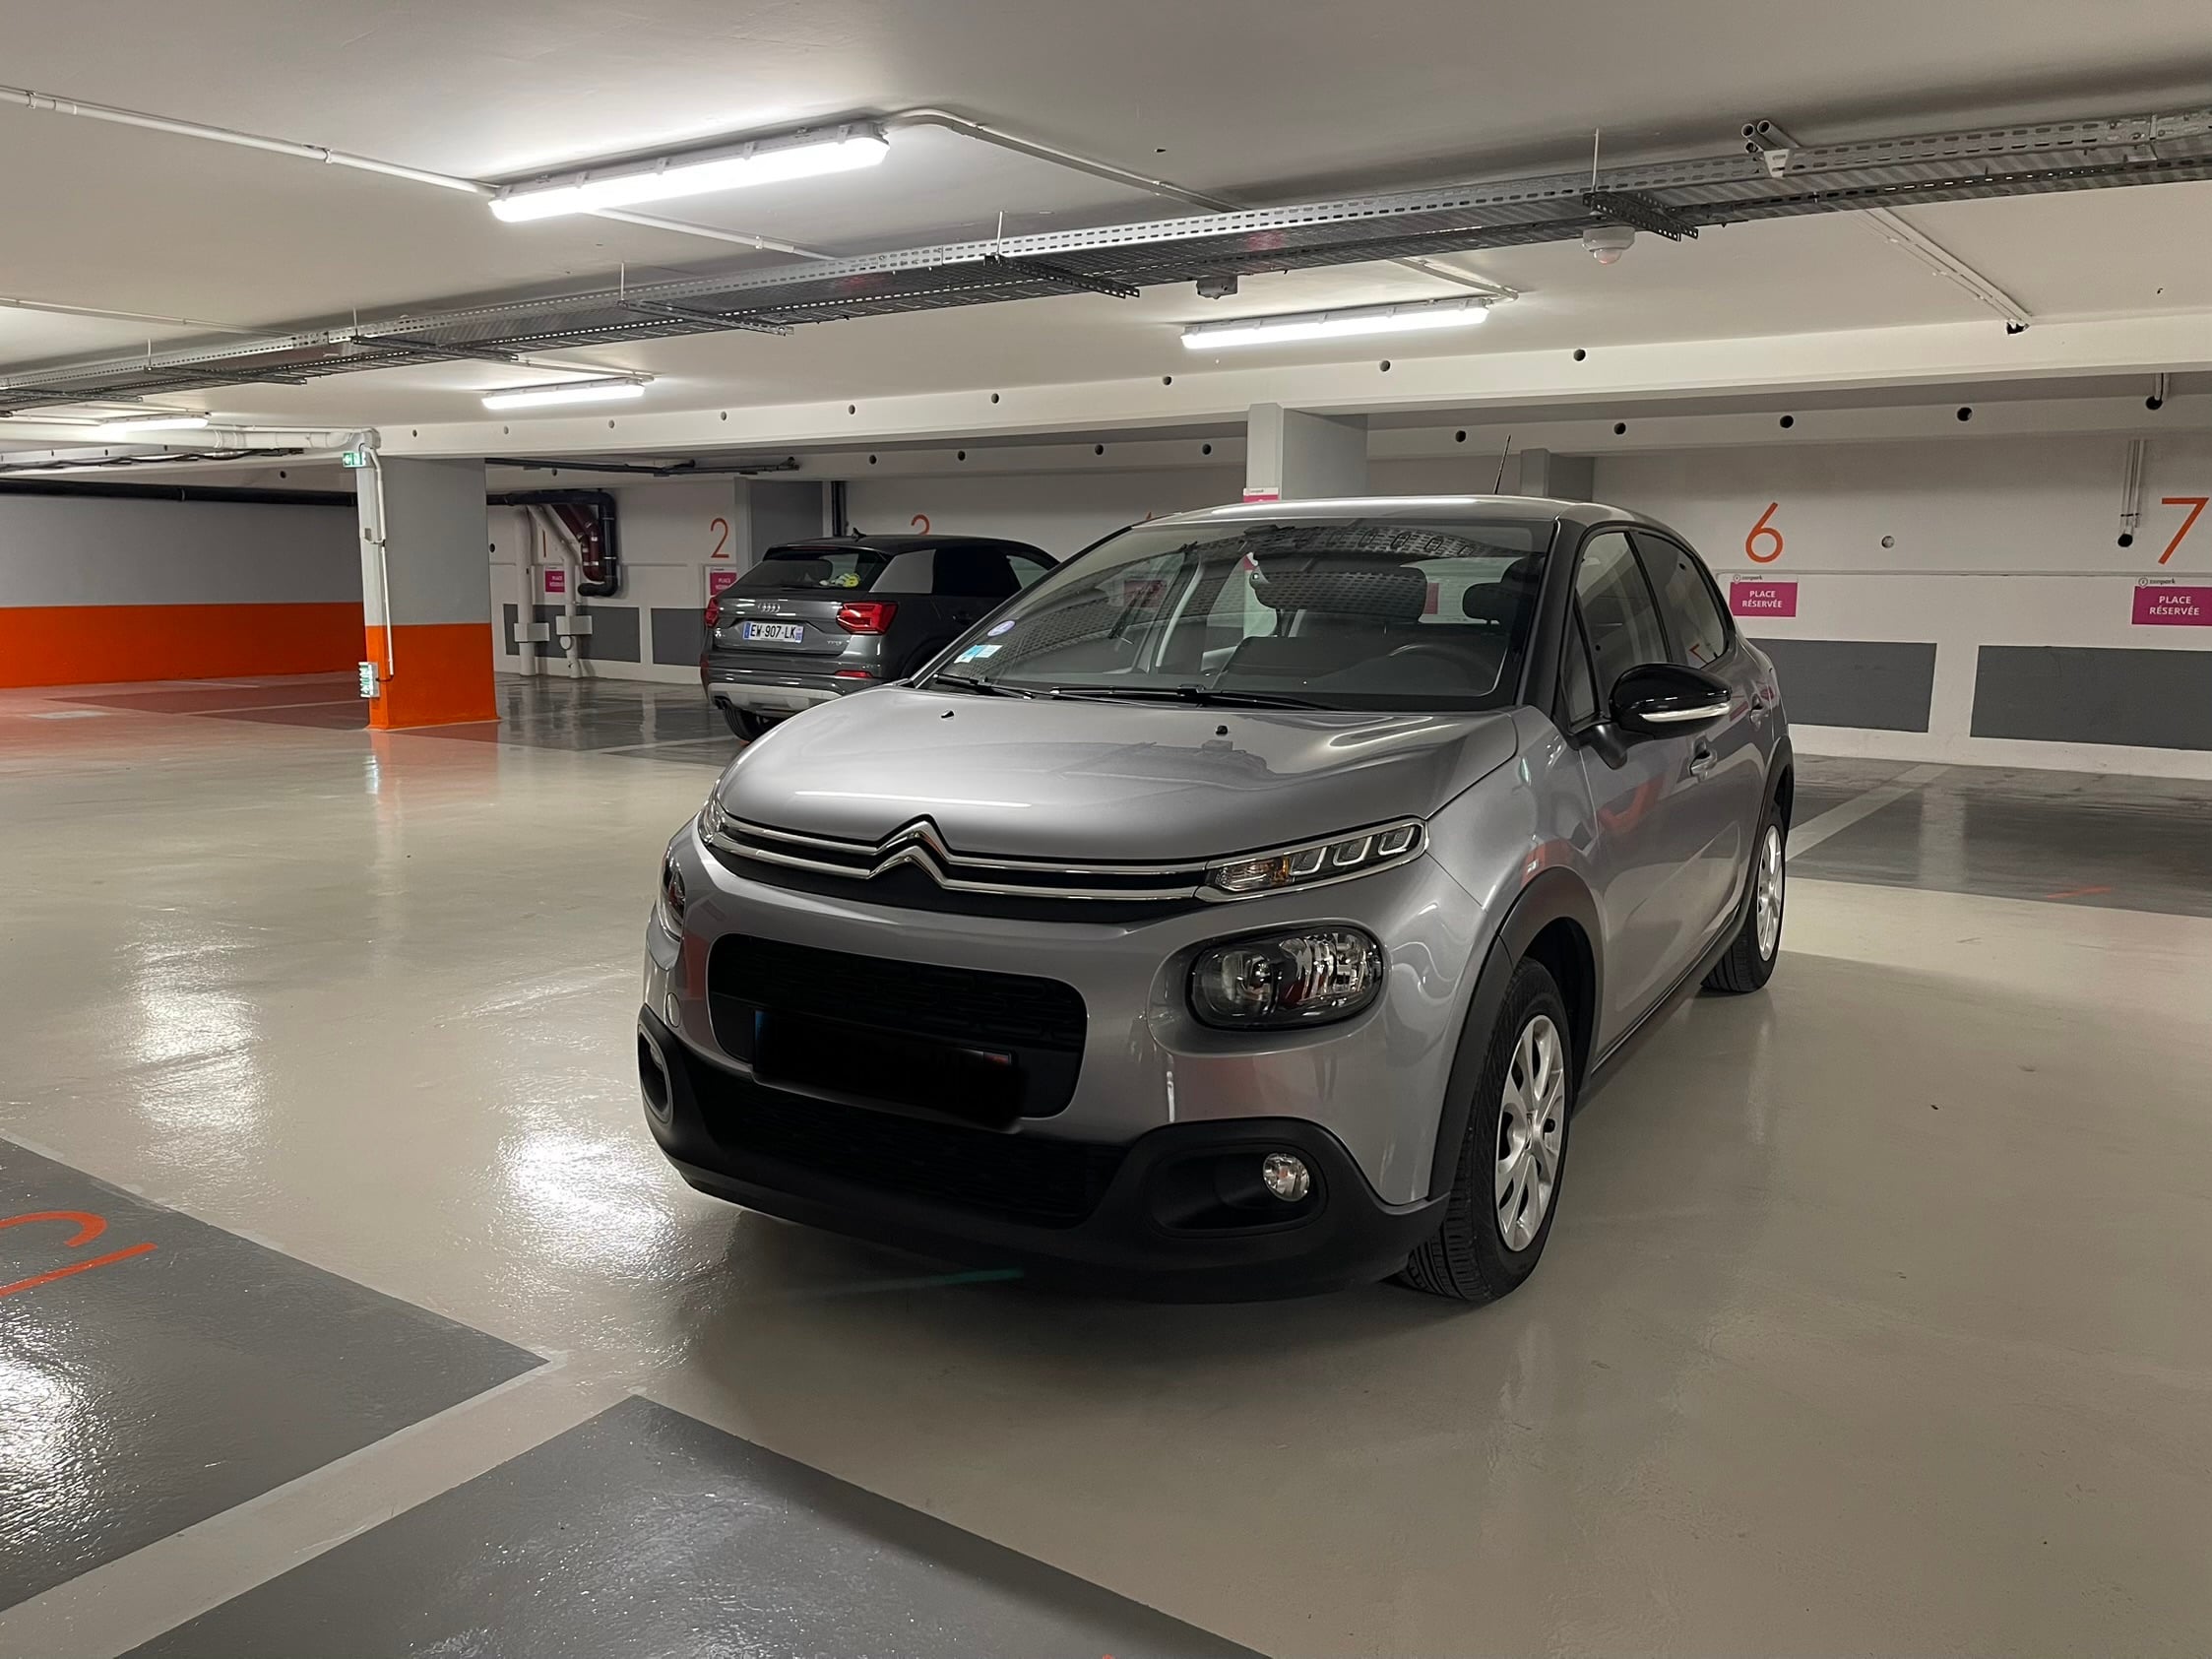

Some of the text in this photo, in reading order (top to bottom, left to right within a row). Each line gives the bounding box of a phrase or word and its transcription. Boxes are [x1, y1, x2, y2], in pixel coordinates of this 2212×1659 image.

[711, 517, 729, 558] 2
[1745, 502, 1784, 563] 6
[2158, 497, 2209, 565] 7
[1741, 599, 1783, 608] RÉSERVÉE
[2149, 606, 2200, 615] RÉSERVÉE
[2159, 596, 2192, 605] PLACE
